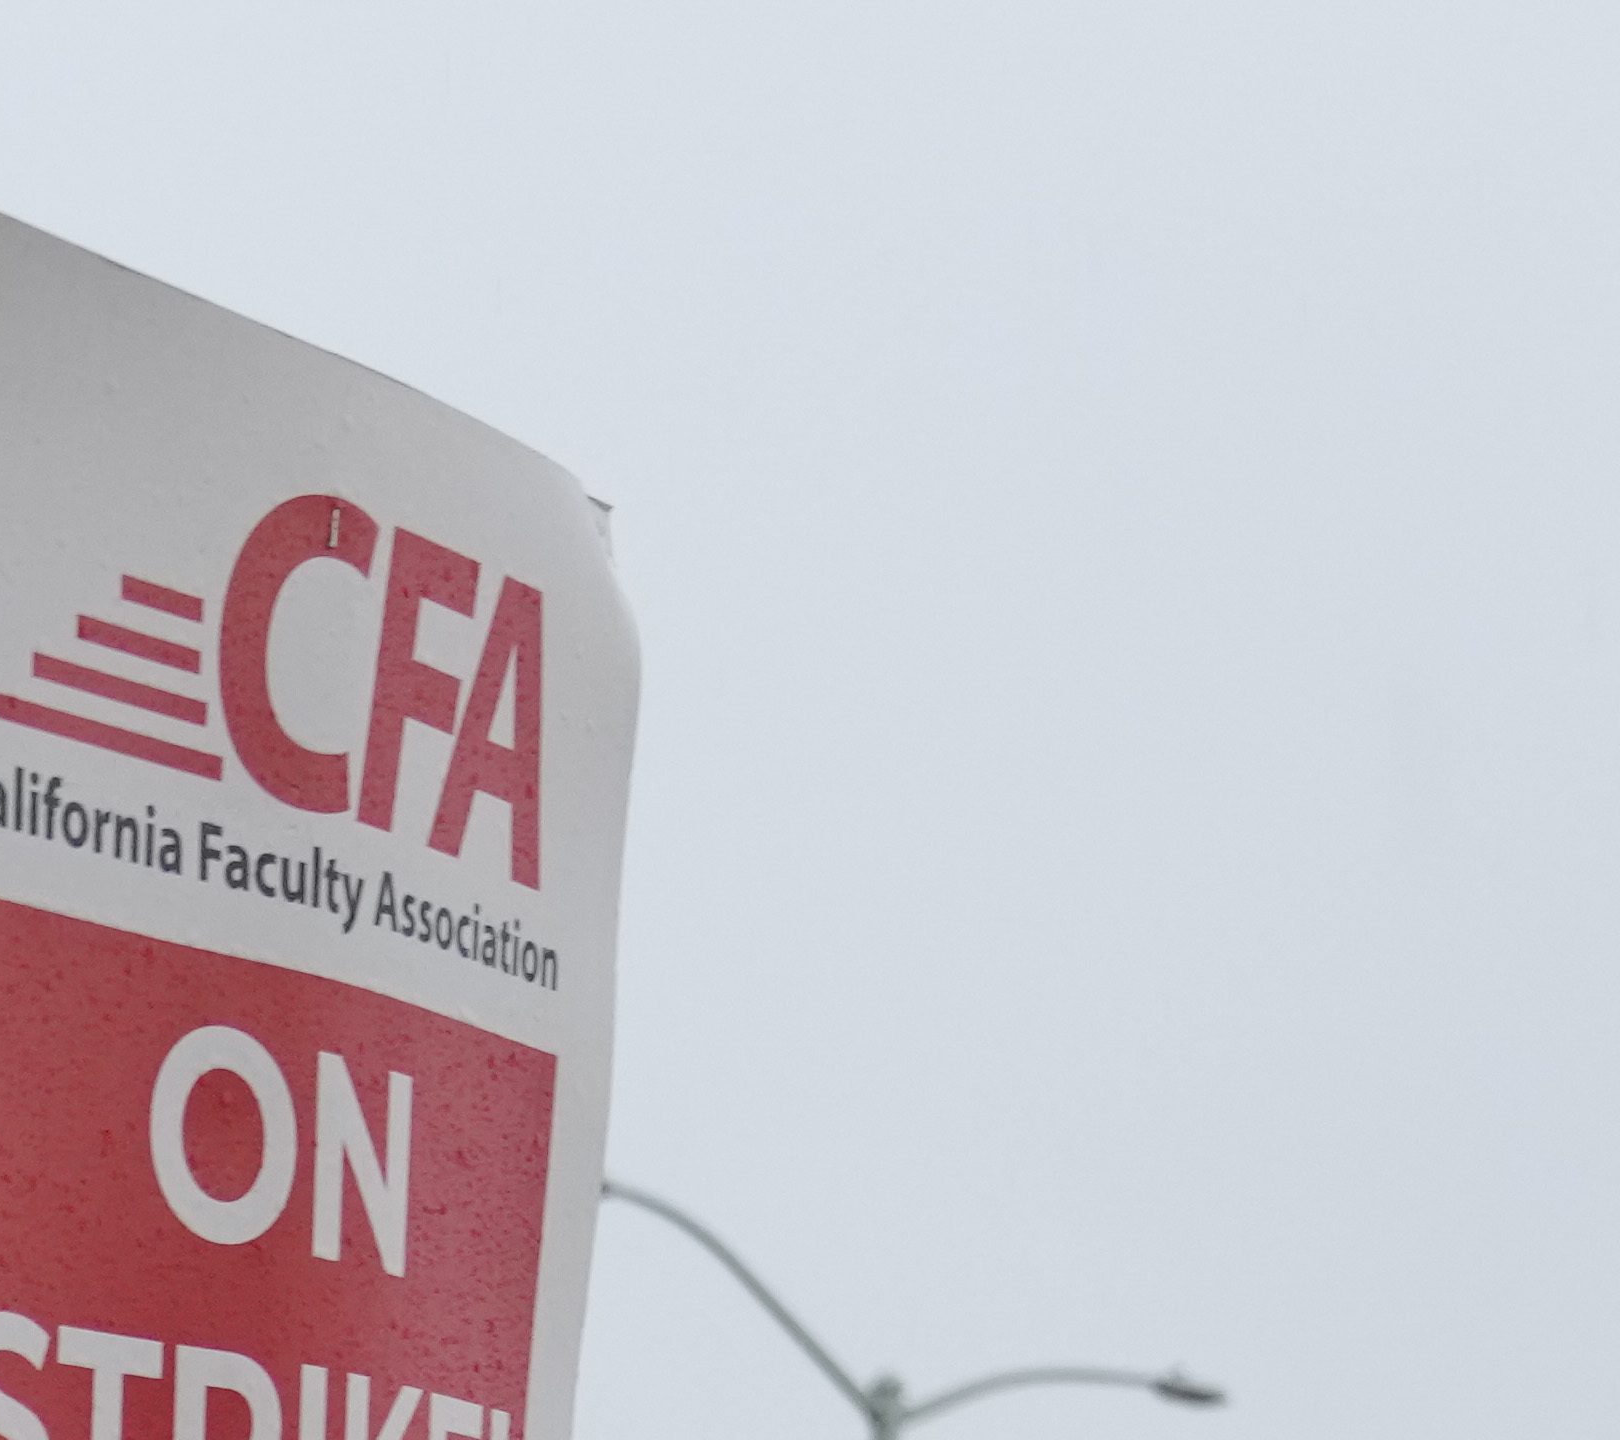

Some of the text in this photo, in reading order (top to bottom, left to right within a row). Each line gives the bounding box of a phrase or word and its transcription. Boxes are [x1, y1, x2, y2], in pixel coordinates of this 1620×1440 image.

[218, 493, 544, 892] CFA
[197, 822, 364, 934] Faculty
[373, 869, 559, 991] Association
[148, 1024, 414, 1278] ON
